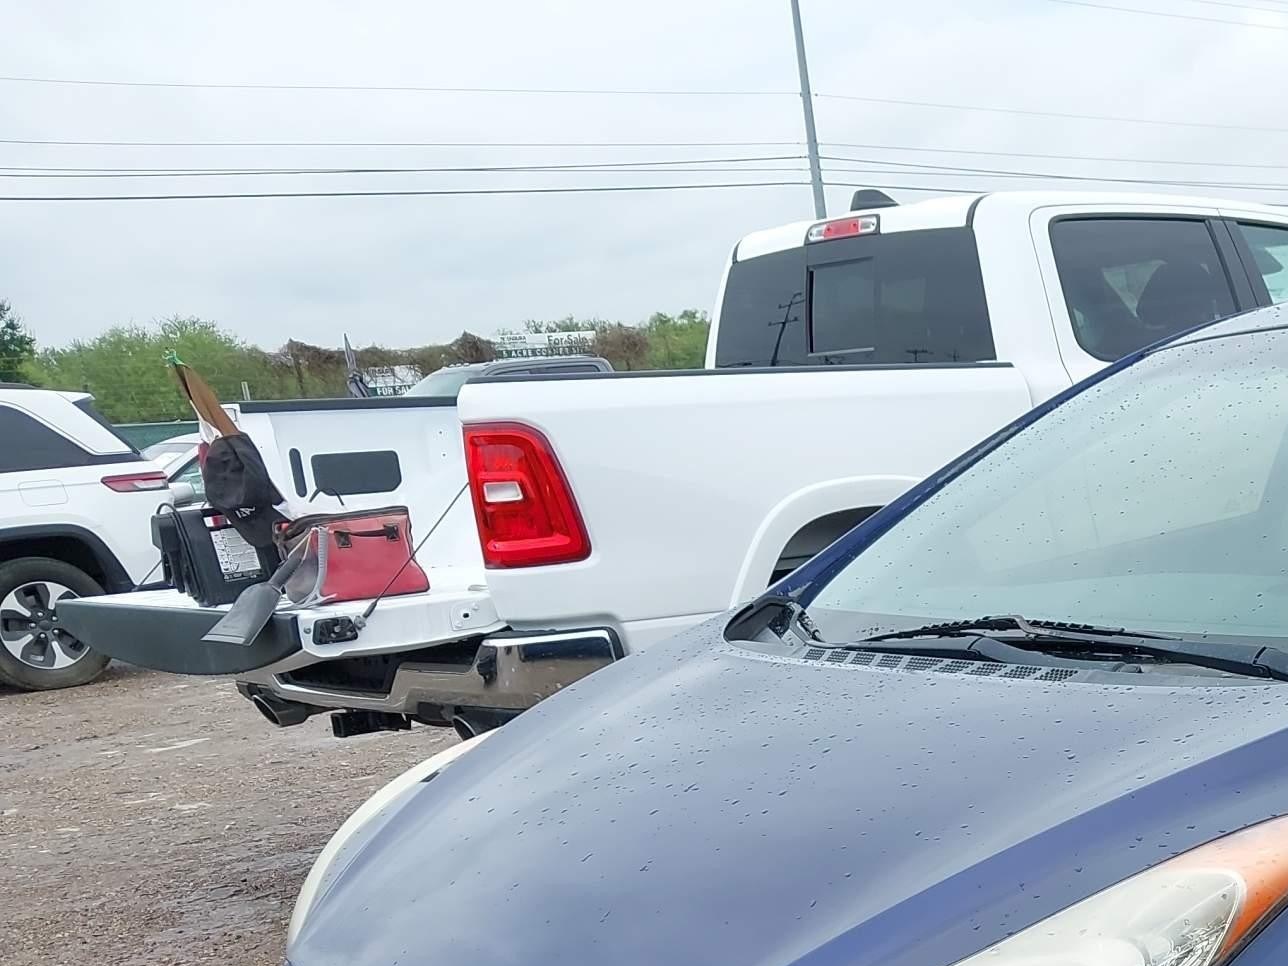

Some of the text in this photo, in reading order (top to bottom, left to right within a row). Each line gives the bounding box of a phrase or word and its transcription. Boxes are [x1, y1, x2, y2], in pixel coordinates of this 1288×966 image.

[547, 334, 565, 347] For
[511, 348, 533, 358] ACRE
[376, 387, 393, 396] FOR
